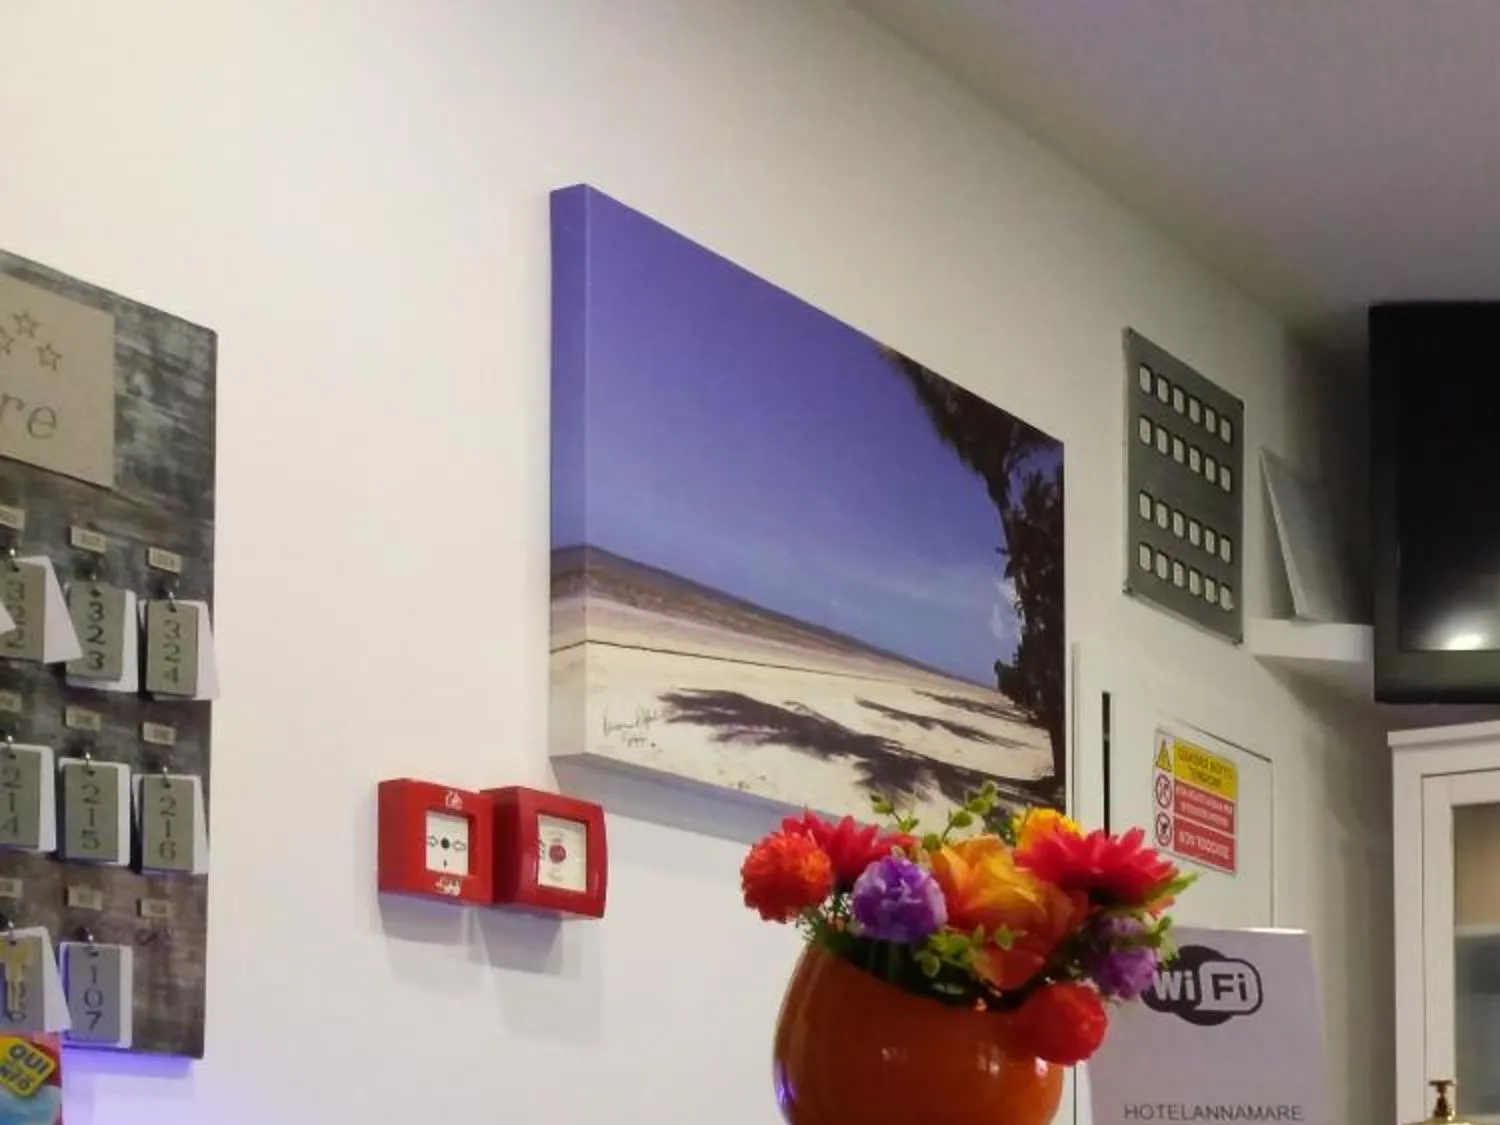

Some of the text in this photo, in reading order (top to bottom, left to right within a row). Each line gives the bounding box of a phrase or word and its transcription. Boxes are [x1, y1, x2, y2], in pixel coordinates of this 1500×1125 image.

[86, 601, 106, 671] 323
[81, 783, 101, 850] 215
[84, 965, 104, 1032] 107
[1123, 1103, 1305, 1122] HOTELANNAMARE
